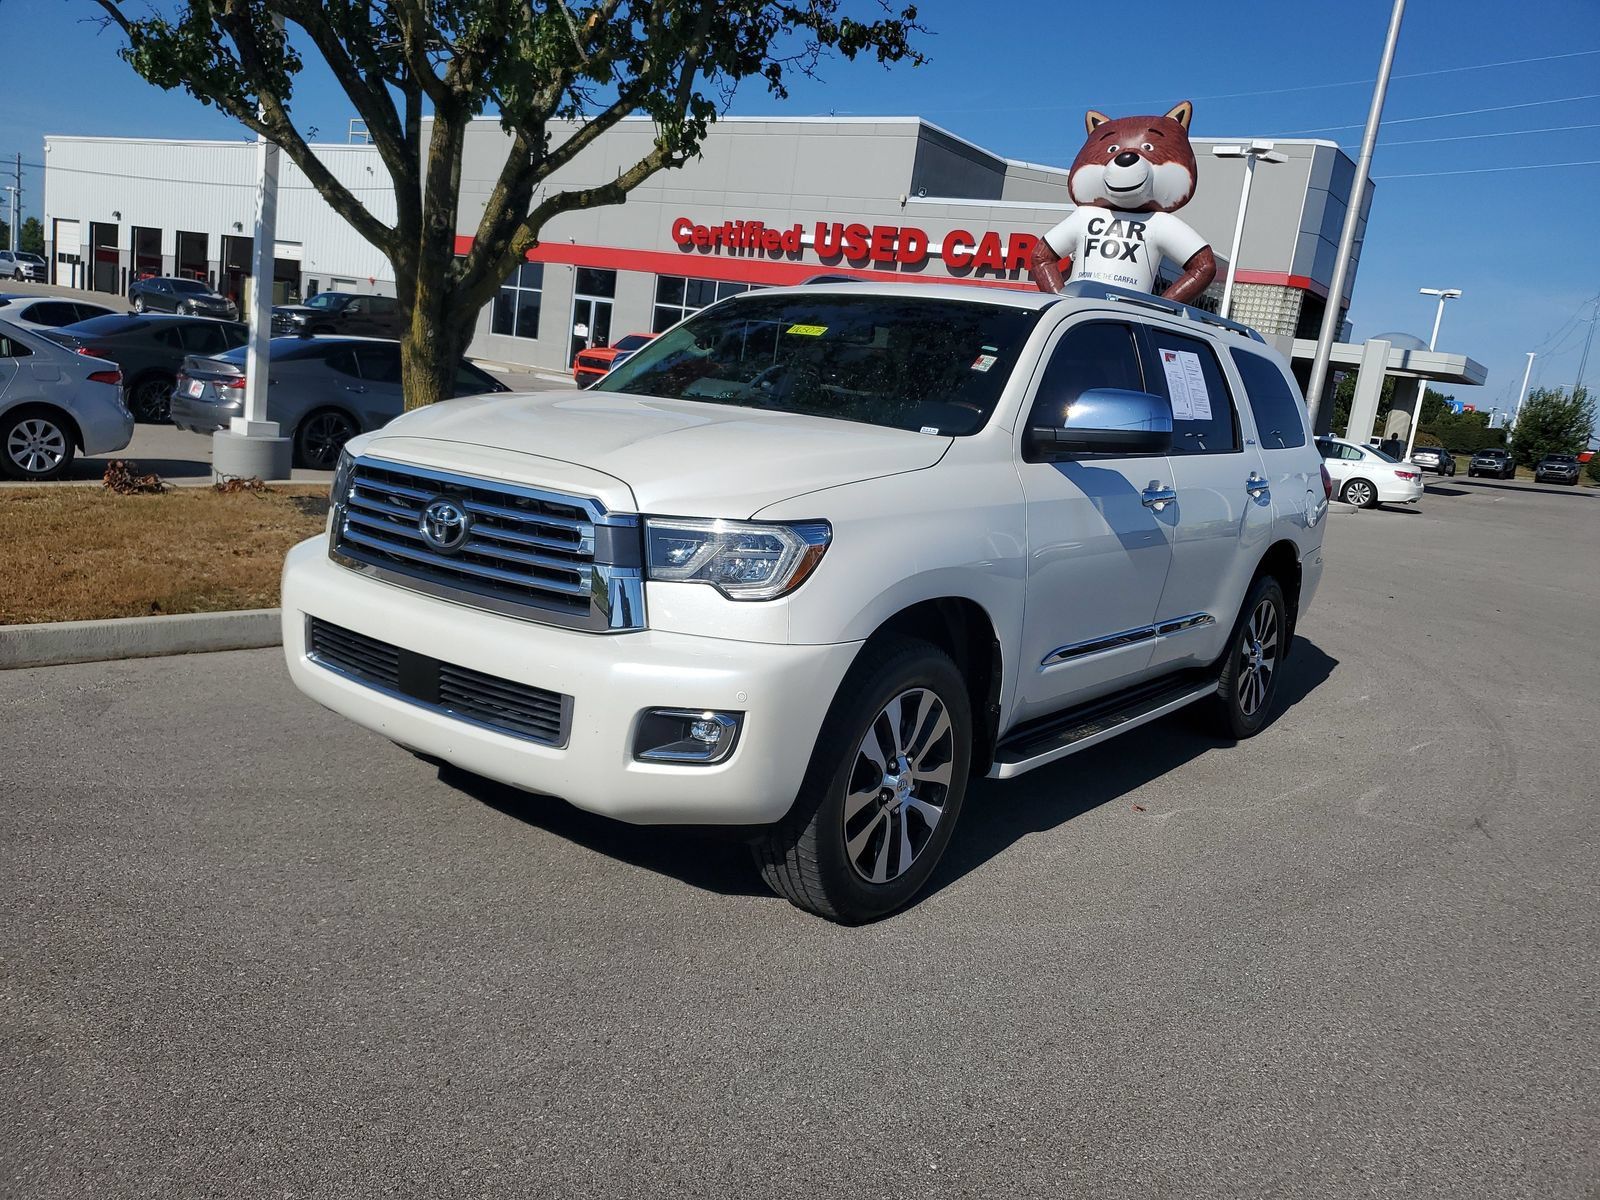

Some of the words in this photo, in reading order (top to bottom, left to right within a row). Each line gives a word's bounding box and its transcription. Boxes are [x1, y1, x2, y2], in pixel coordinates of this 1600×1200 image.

[1087, 217, 1147, 242] CAR
[672, 217, 803, 251] Certified
[813, 222, 928, 264] USED
[942, 230, 1070, 272] CAR
[1084, 238, 1141, 264] FOX
[1113, 274, 1138, 285] CARFAX
